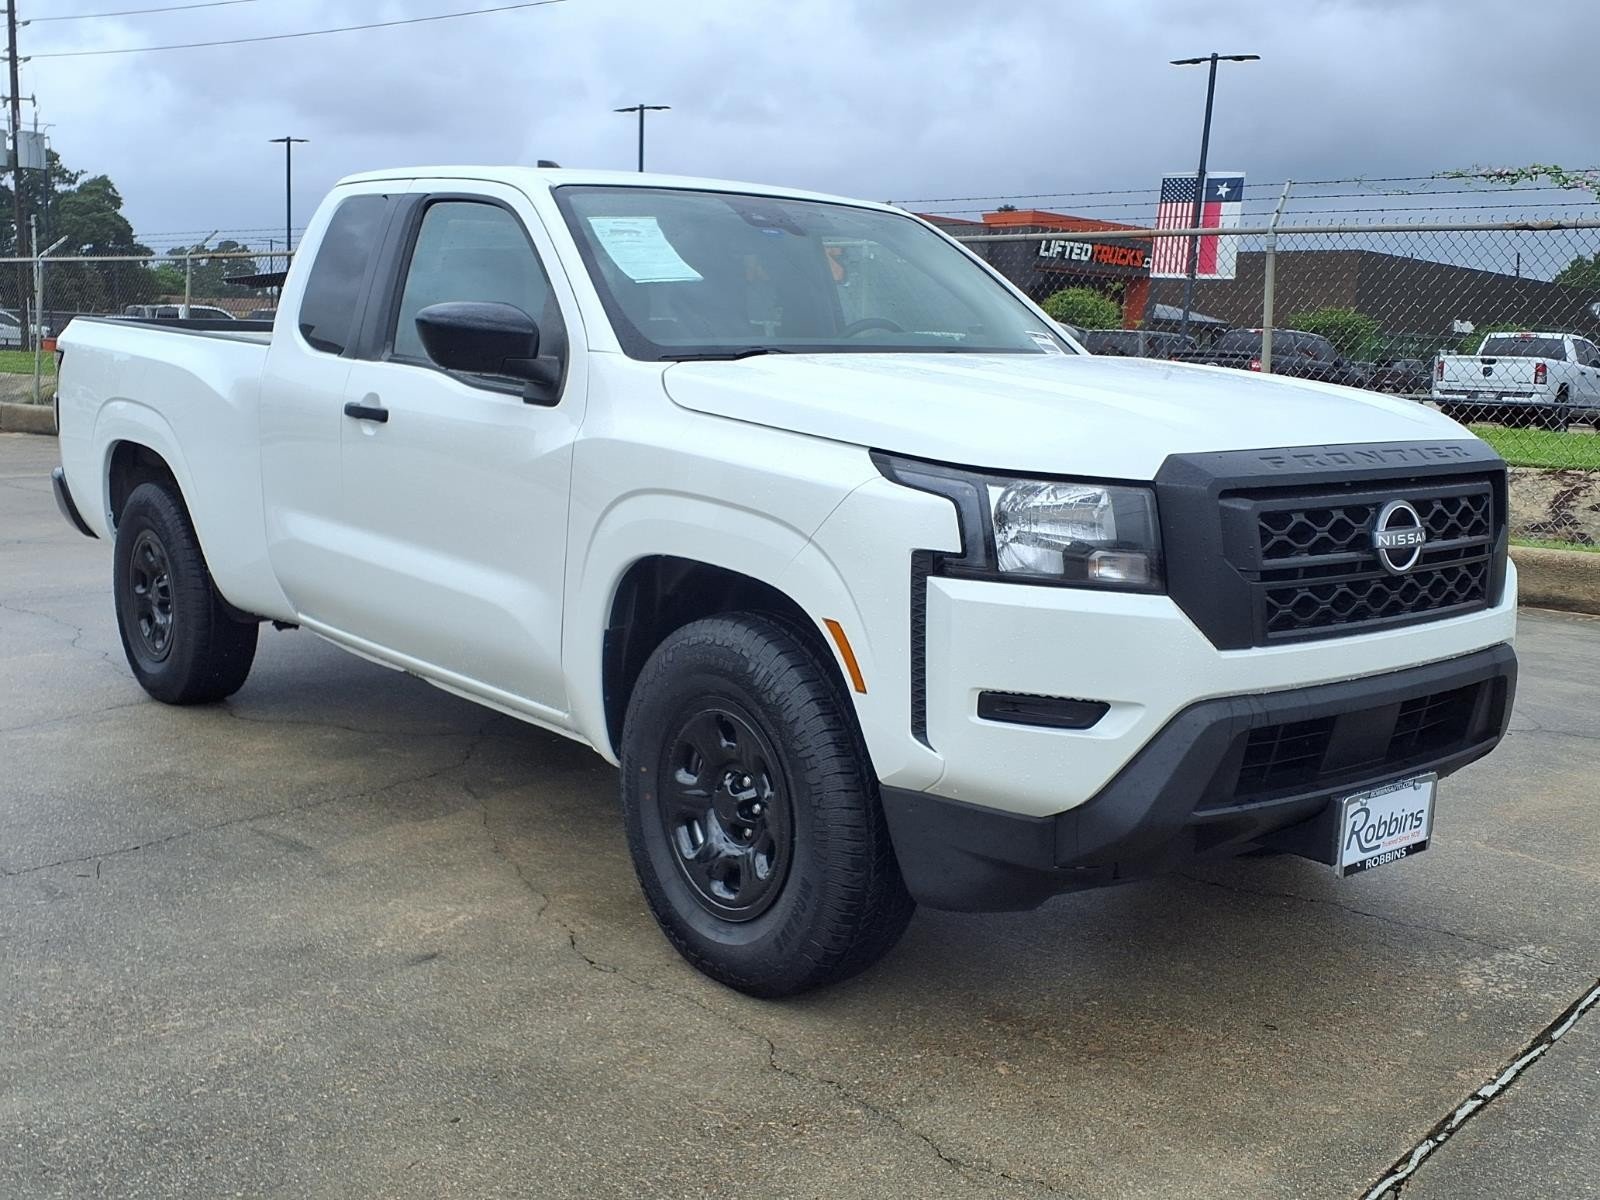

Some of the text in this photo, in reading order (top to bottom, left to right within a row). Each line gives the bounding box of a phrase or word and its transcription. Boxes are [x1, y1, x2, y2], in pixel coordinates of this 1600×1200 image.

[1259, 446, 1472, 468] FRONTIER
[1345, 807, 1424, 853] Robbins
[1365, 847, 1407, 869] ROBBINS
